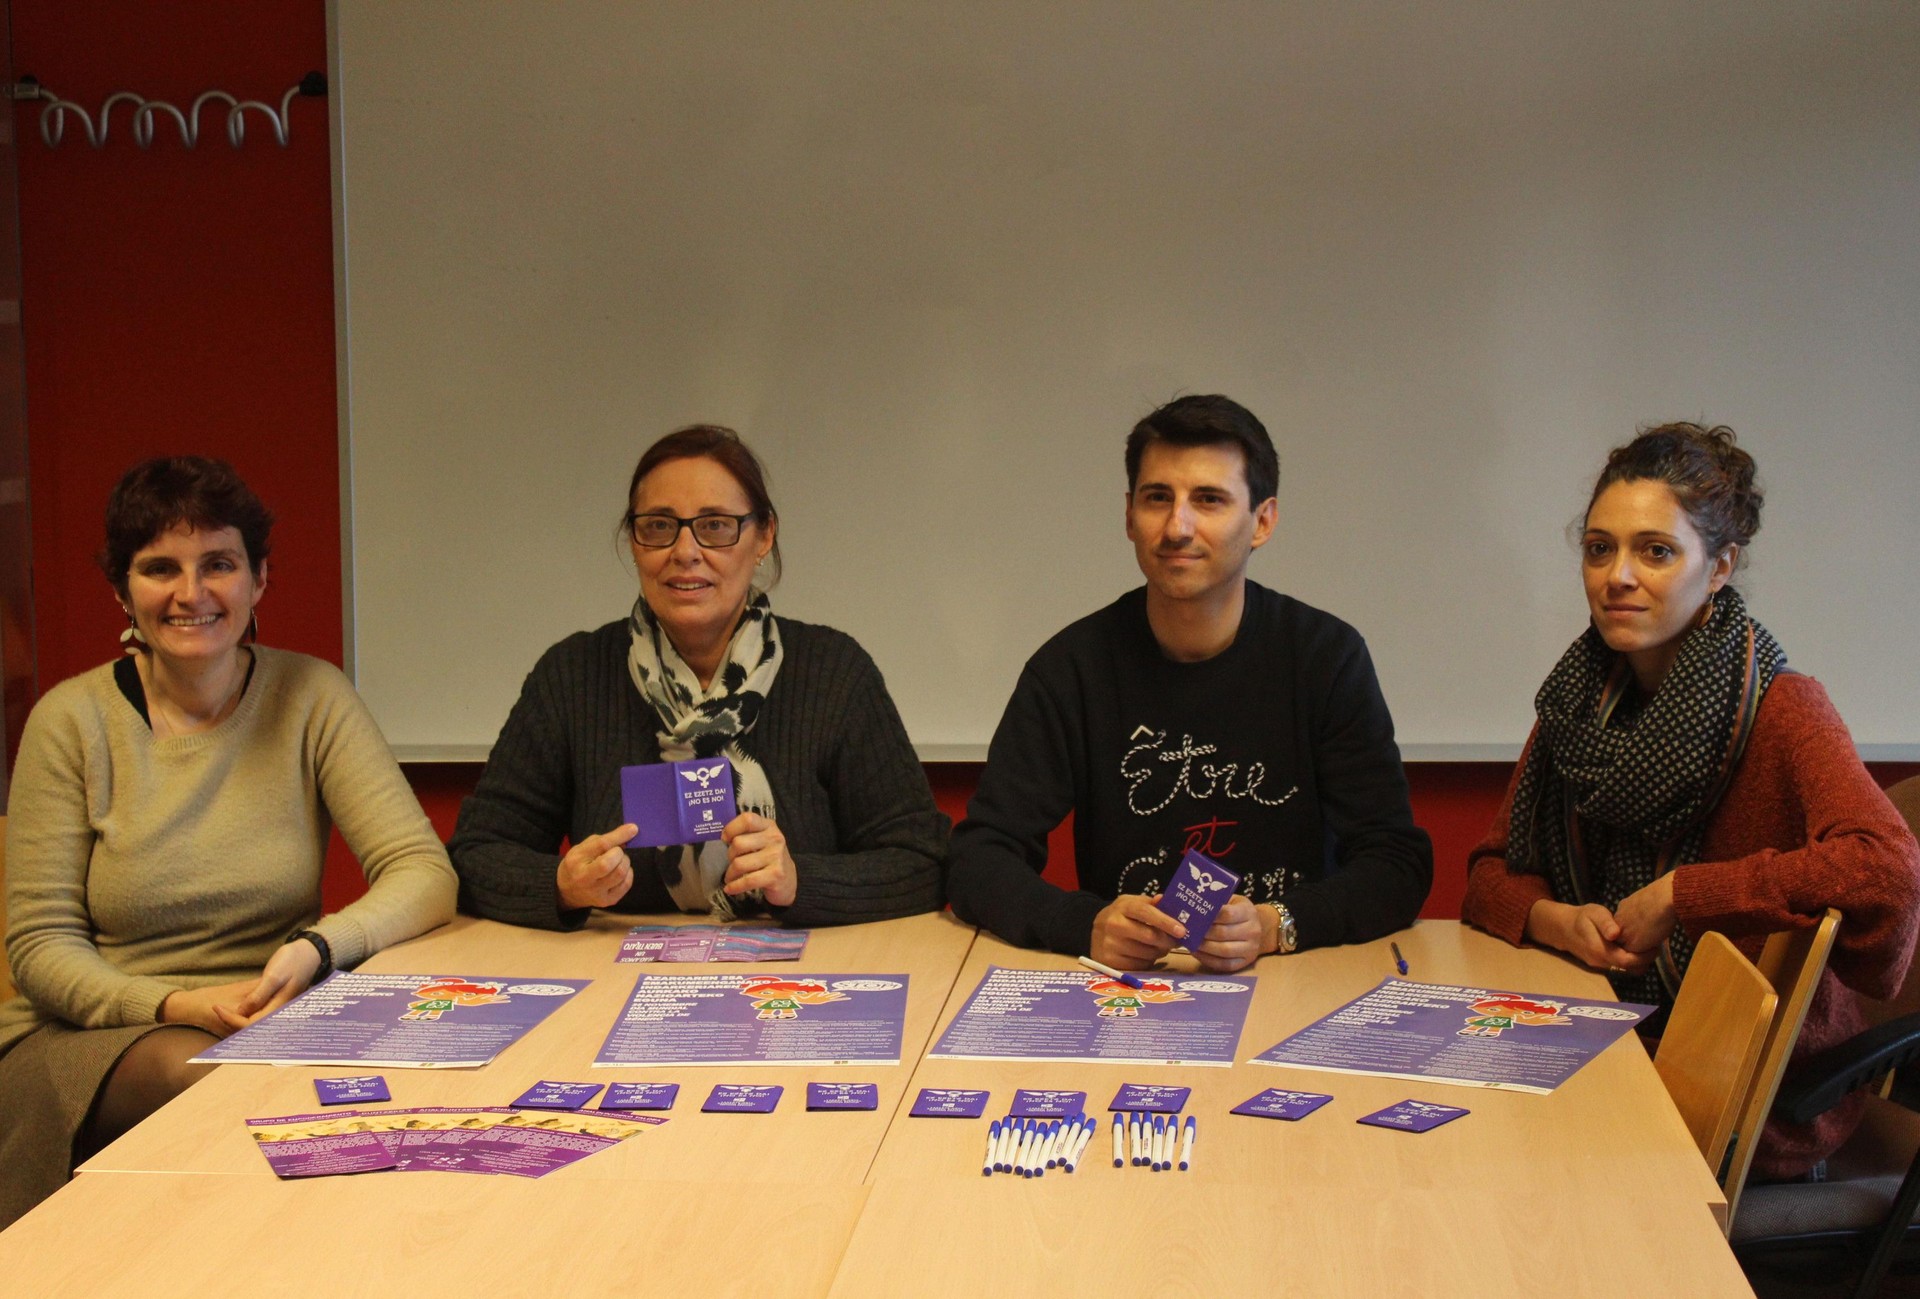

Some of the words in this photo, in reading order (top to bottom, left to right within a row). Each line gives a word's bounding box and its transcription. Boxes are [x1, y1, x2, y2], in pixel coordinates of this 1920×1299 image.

[1178, 882, 1185, 892] EZ
[1185, 888, 1204, 904] EZETZ
[1202, 899, 1214, 912] DA!
[1187, 897, 1196, 907] ES
[1194, 902, 1207, 915] NO!
